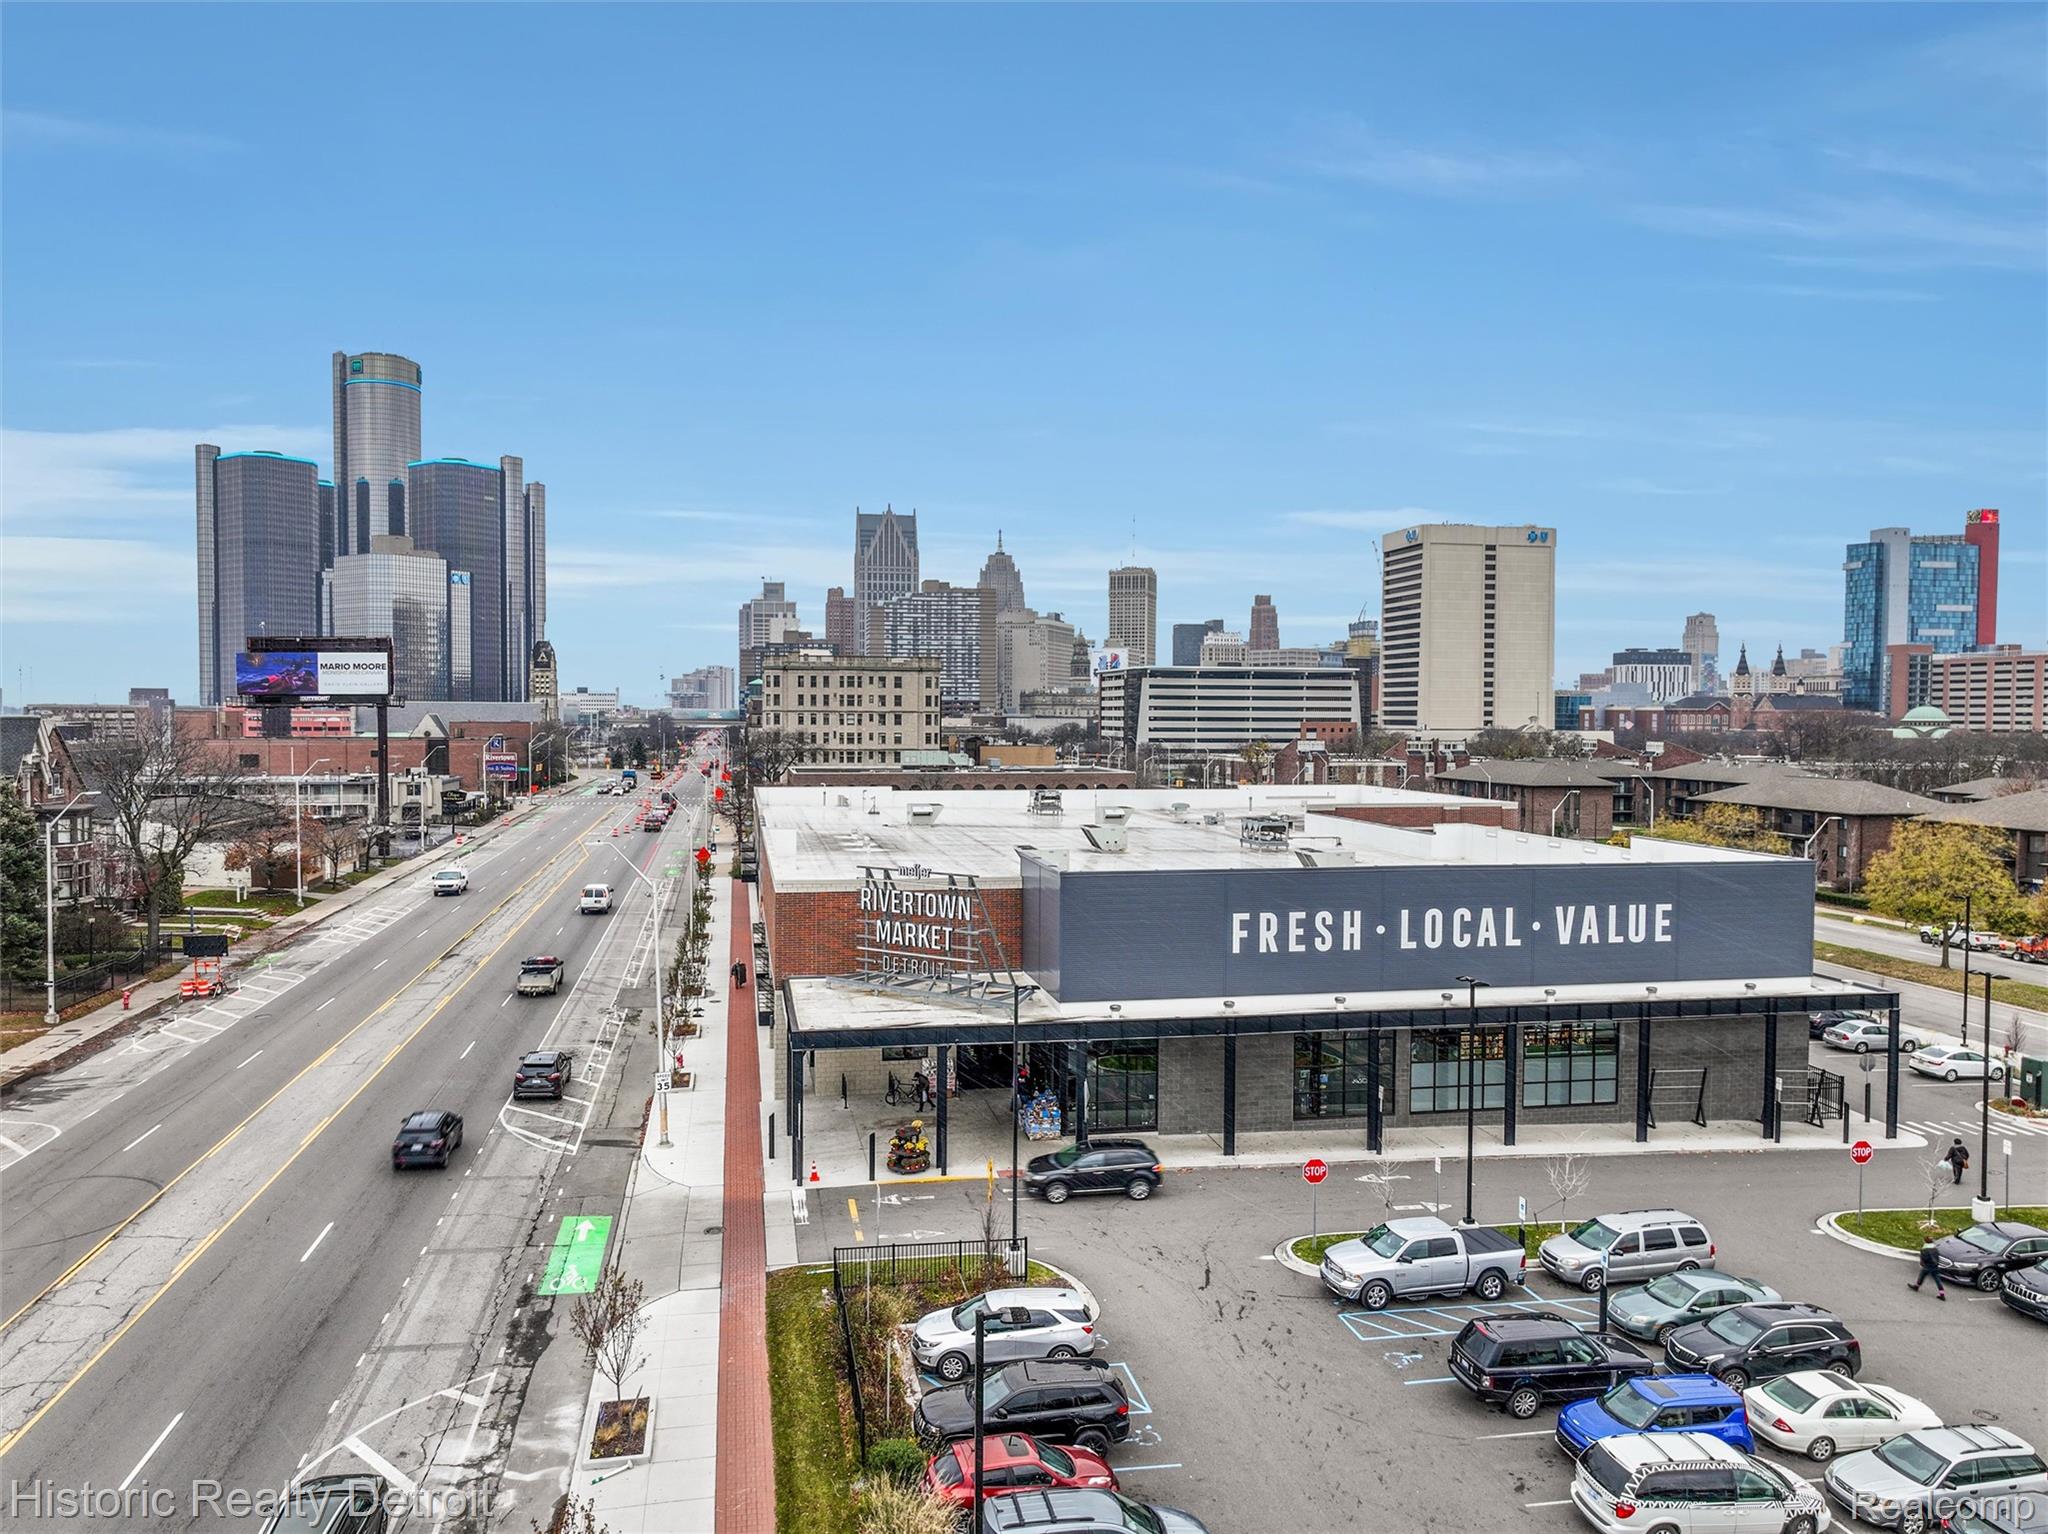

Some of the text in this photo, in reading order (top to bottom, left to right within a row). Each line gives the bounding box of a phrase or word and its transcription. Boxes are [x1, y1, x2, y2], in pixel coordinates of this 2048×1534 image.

[353, 662, 387, 670] MOORE
[898, 864, 932, 880] meijer
[861, 887, 971, 921] RIVERTOWN
[876, 919, 953, 951] MARKET
[1232, 903, 1673, 953] FRESH LOCAL VALUE
[882, 955, 945, 978] DETROIT
[657, 1081, 670, 1091] 35
[1853, 1147, 1871, 1157] STOP
[1305, 1166, 1326, 1176] STOP
